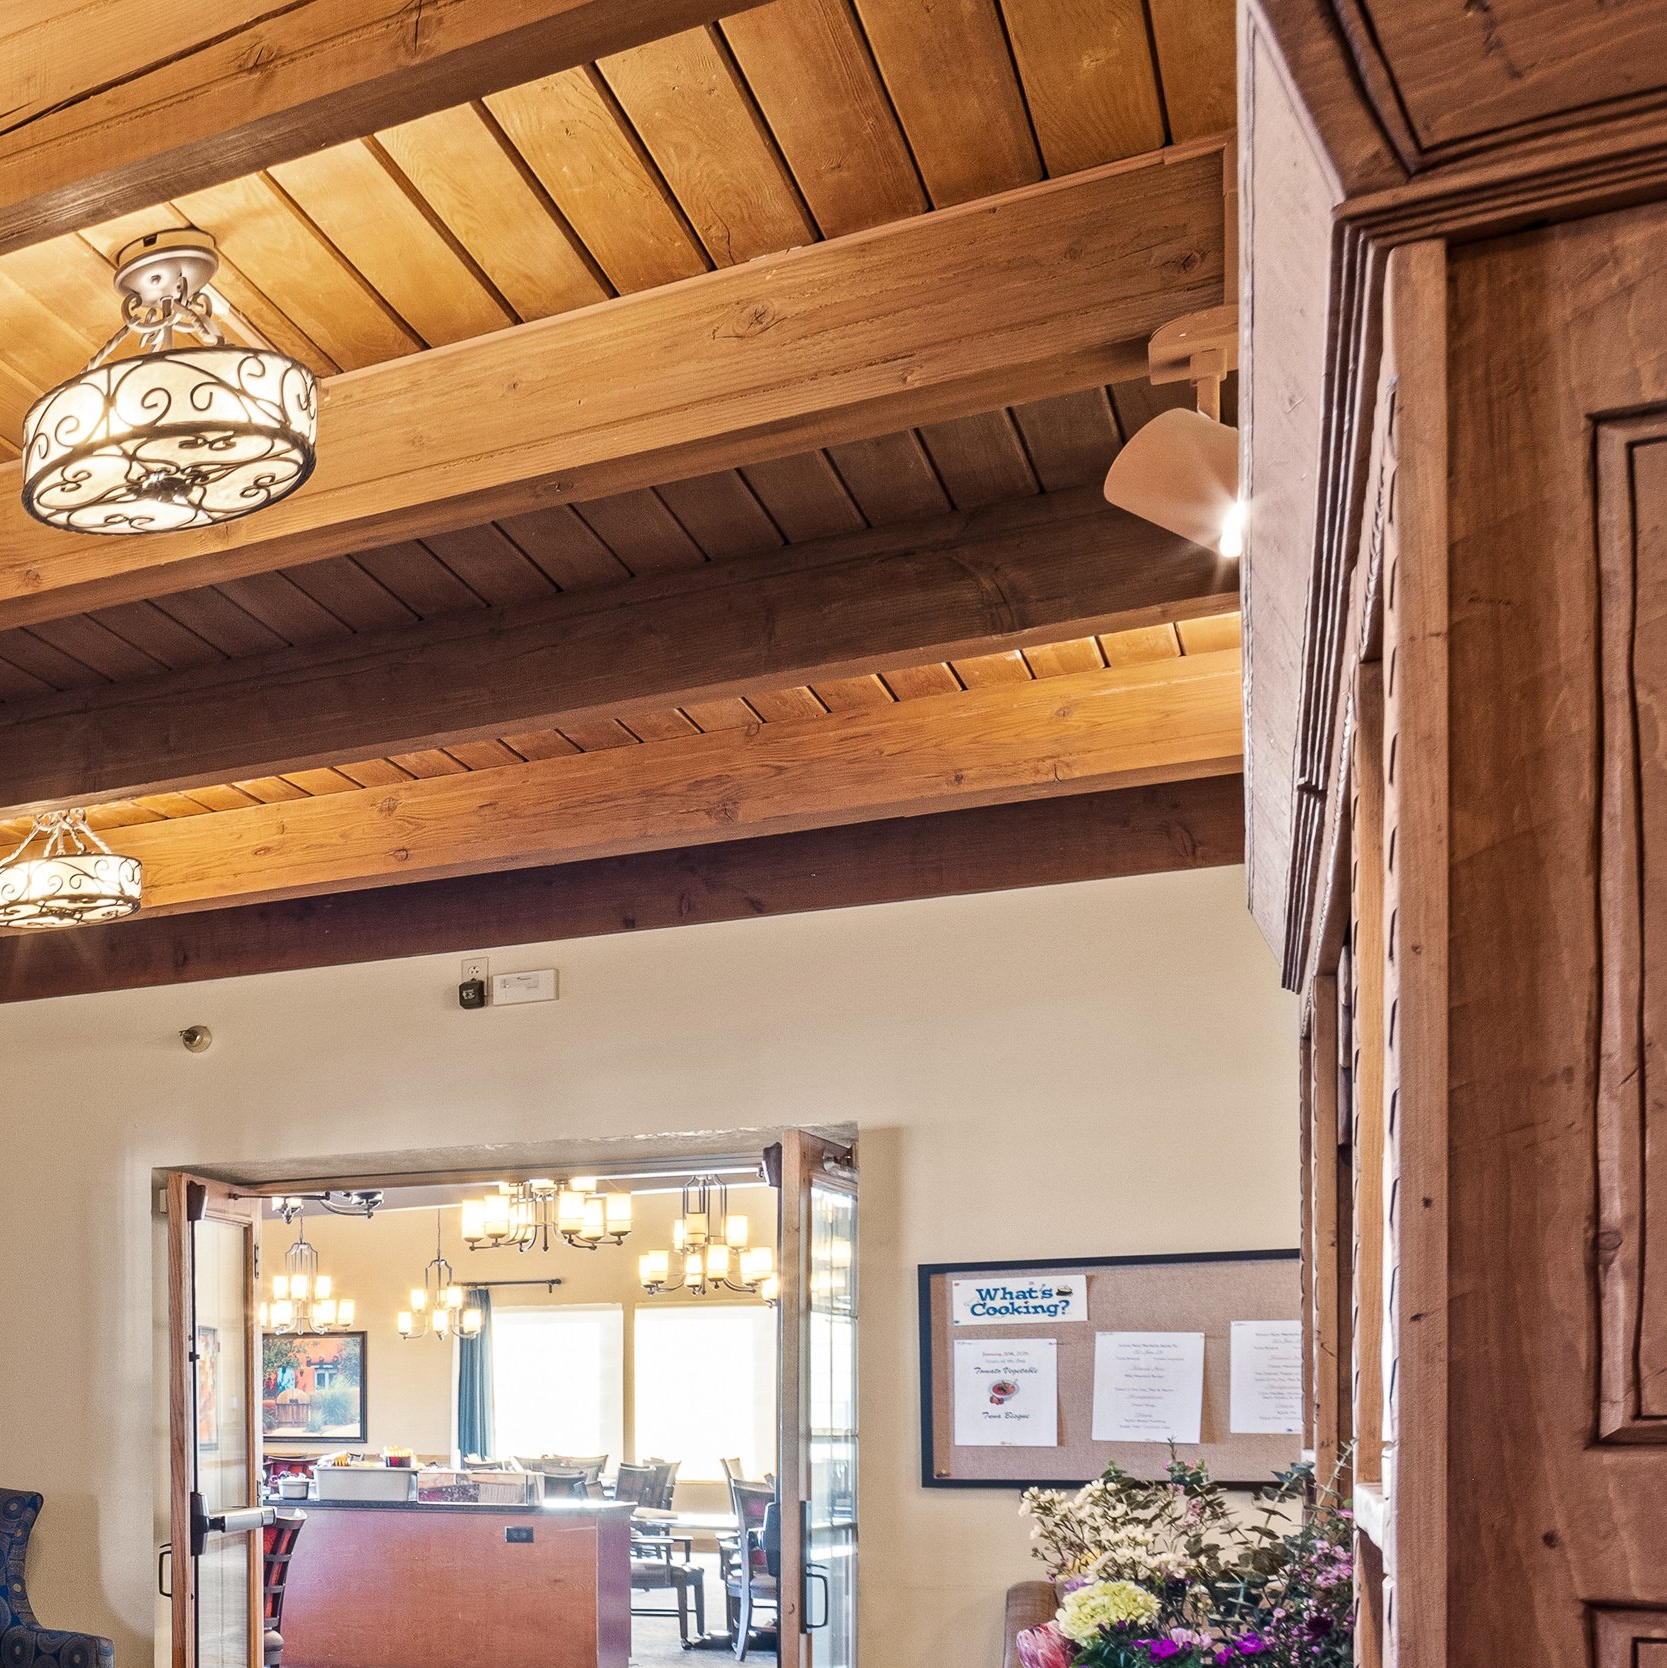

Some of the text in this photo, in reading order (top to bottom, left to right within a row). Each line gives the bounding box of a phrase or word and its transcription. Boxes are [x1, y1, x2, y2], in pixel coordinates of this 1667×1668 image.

[976, 1285, 1053, 1301] What's
[970, 1299, 1070, 1317] Cooking?
[974, 1366, 1038, 1375] Tomato Vegetable
